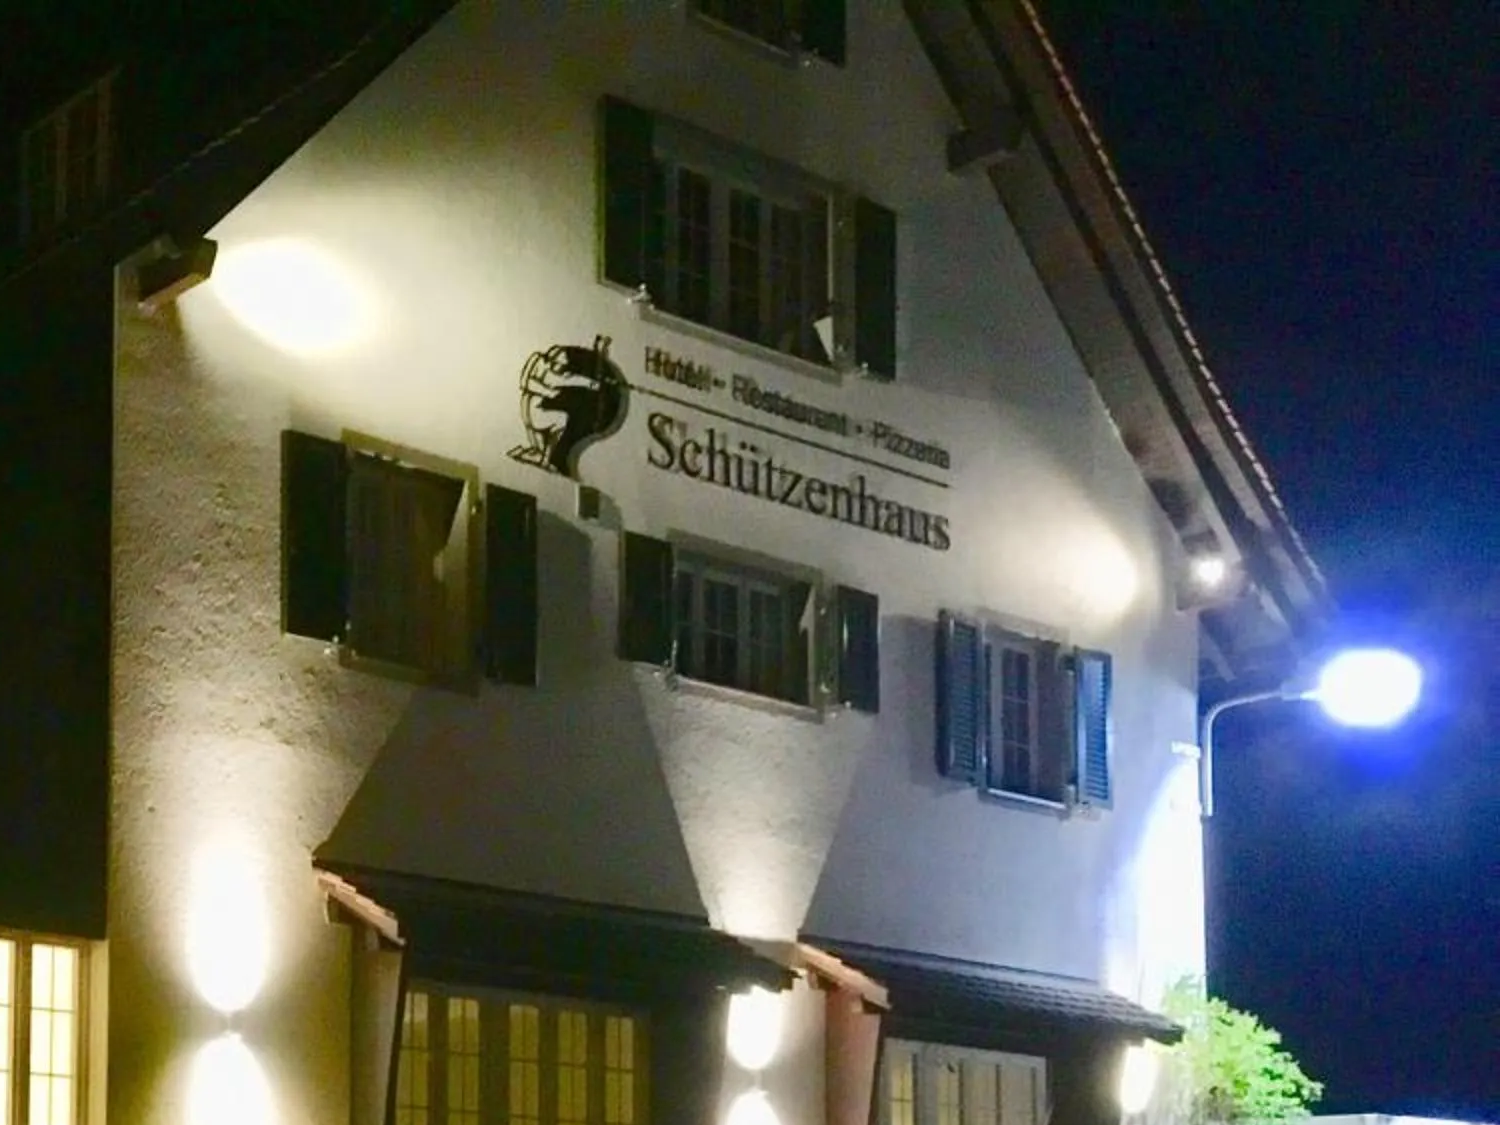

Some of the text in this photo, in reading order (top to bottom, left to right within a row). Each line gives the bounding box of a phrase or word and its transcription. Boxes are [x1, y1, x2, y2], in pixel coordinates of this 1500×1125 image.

[644, 346, 951, 470] Hotel Restaurant Pizzeria
[647, 411, 952, 551] Schützenhaus
